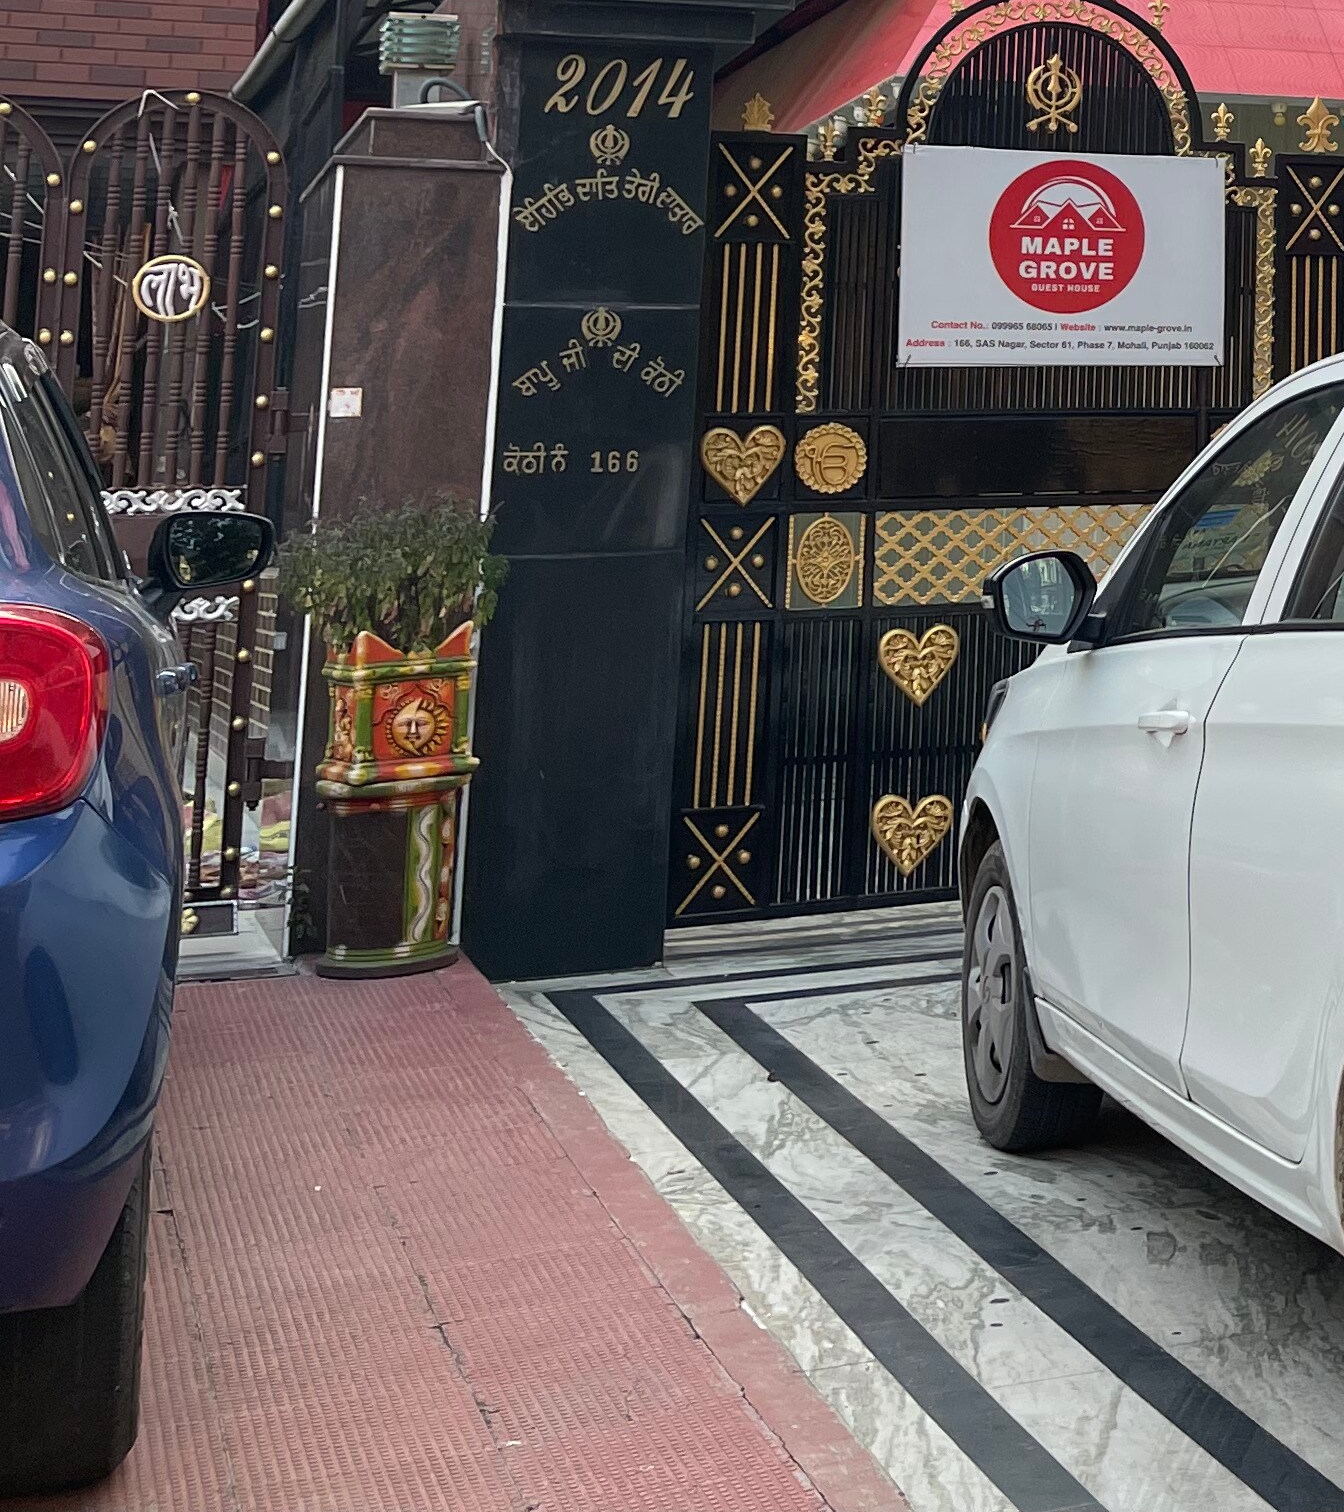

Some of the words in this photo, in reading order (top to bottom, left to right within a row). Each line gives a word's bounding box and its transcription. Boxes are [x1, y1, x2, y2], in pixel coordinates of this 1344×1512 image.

[544, 54, 695, 119] 2014
[1021, 236, 1114, 256] MAPLE
[1019, 260, 1114, 280] GROVE
[140, 263, 202, 317] लाभ
[1067, 284, 1101, 293] HOUSE
[931, 320, 968, 329] Contact
[1060, 323, 1097, 331] Website
[905, 338, 946, 347] Address
[975, 339, 996, 348] SAS
[1029, 340, 1059, 349] Sector
[1077, 341, 1105, 349] Phase
[1151, 341, 1182, 351] Punjab
[559, 339, 586, 373] ਜੀ
[612, 342, 641, 372] ਦੀ
[590, 450, 639, 473] 166
